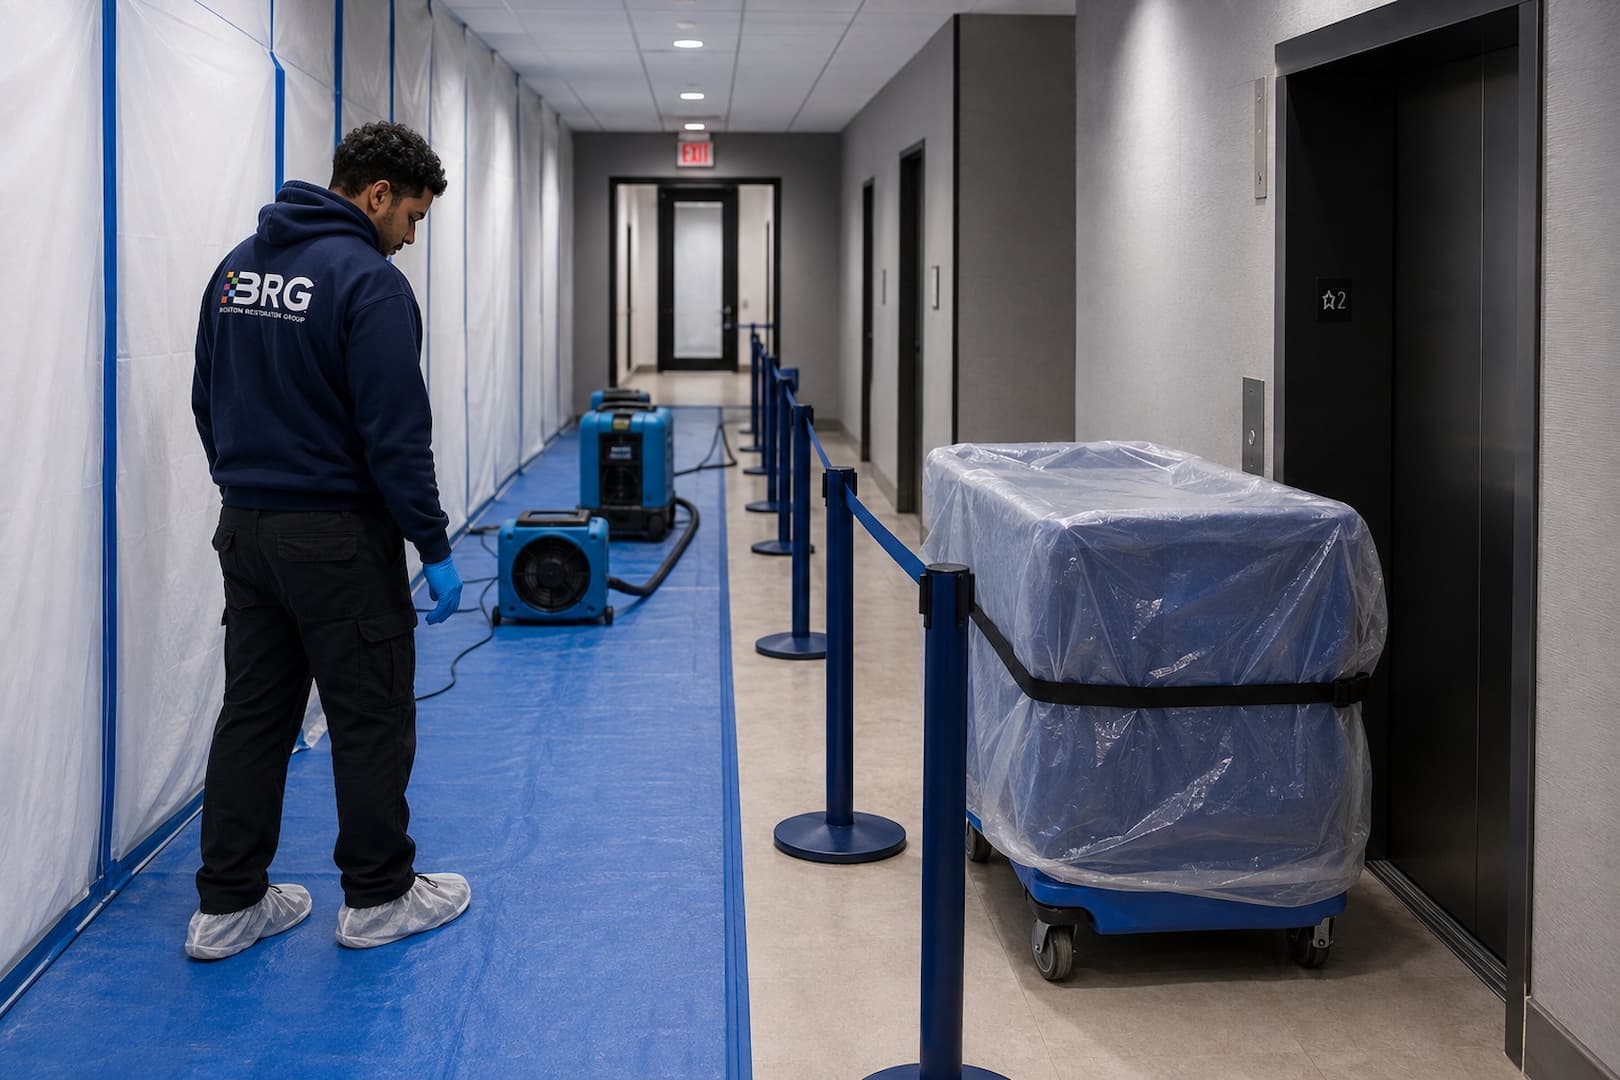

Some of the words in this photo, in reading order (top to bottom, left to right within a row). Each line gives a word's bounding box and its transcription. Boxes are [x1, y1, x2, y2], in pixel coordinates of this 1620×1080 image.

[682, 143, 708, 162] EXIT
[233, 271, 314, 312] BRG
[1337, 290, 1346, 309] 2
